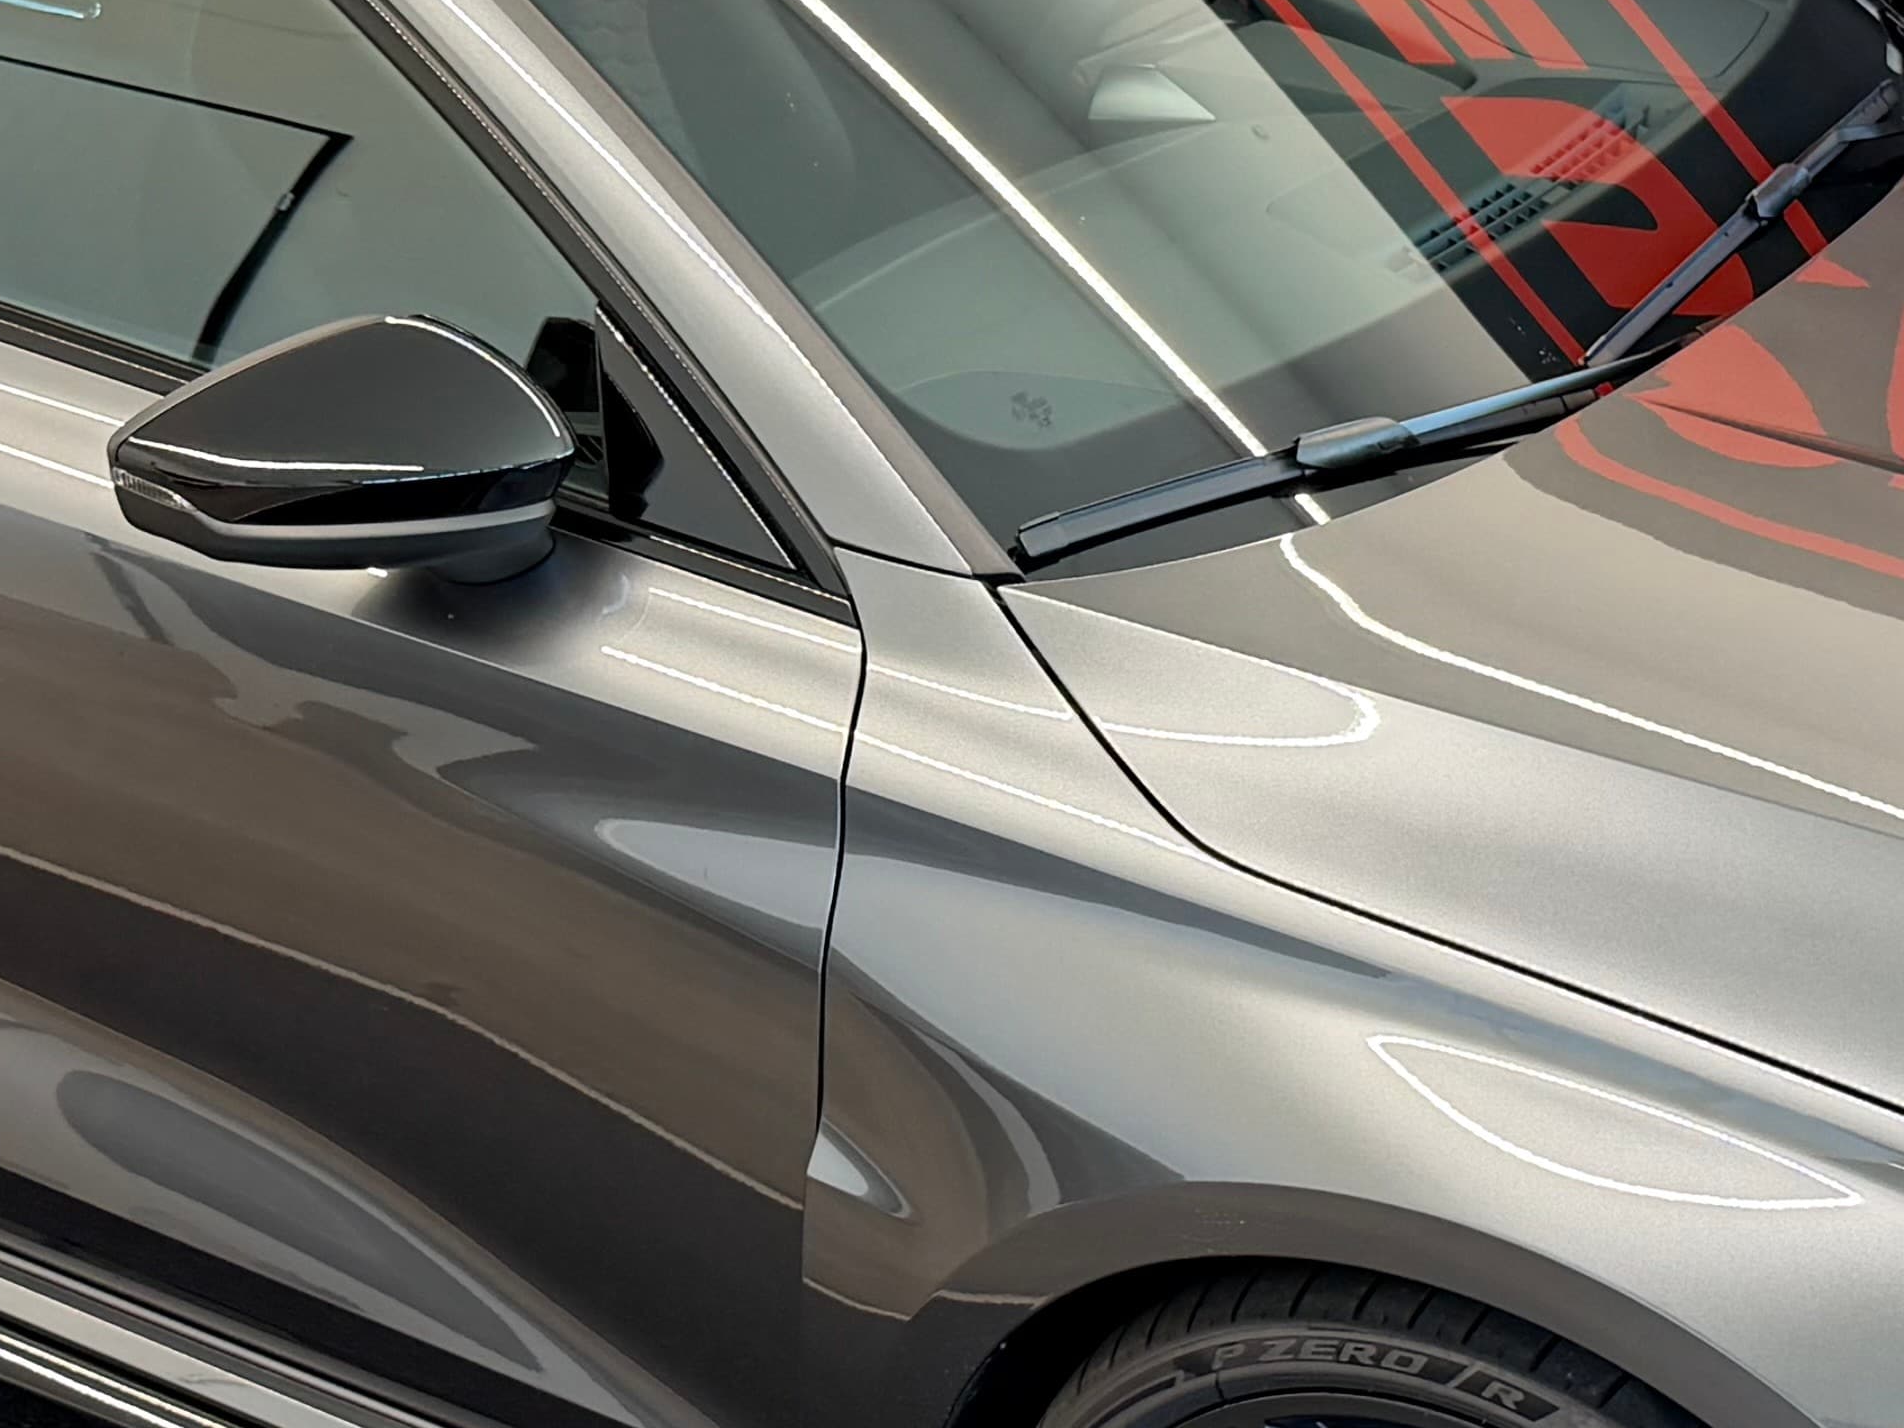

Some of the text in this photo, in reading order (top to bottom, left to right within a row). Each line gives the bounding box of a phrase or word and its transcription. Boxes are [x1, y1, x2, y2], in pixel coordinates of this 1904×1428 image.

[1211, 1338, 1526, 1410] P ZERO R
